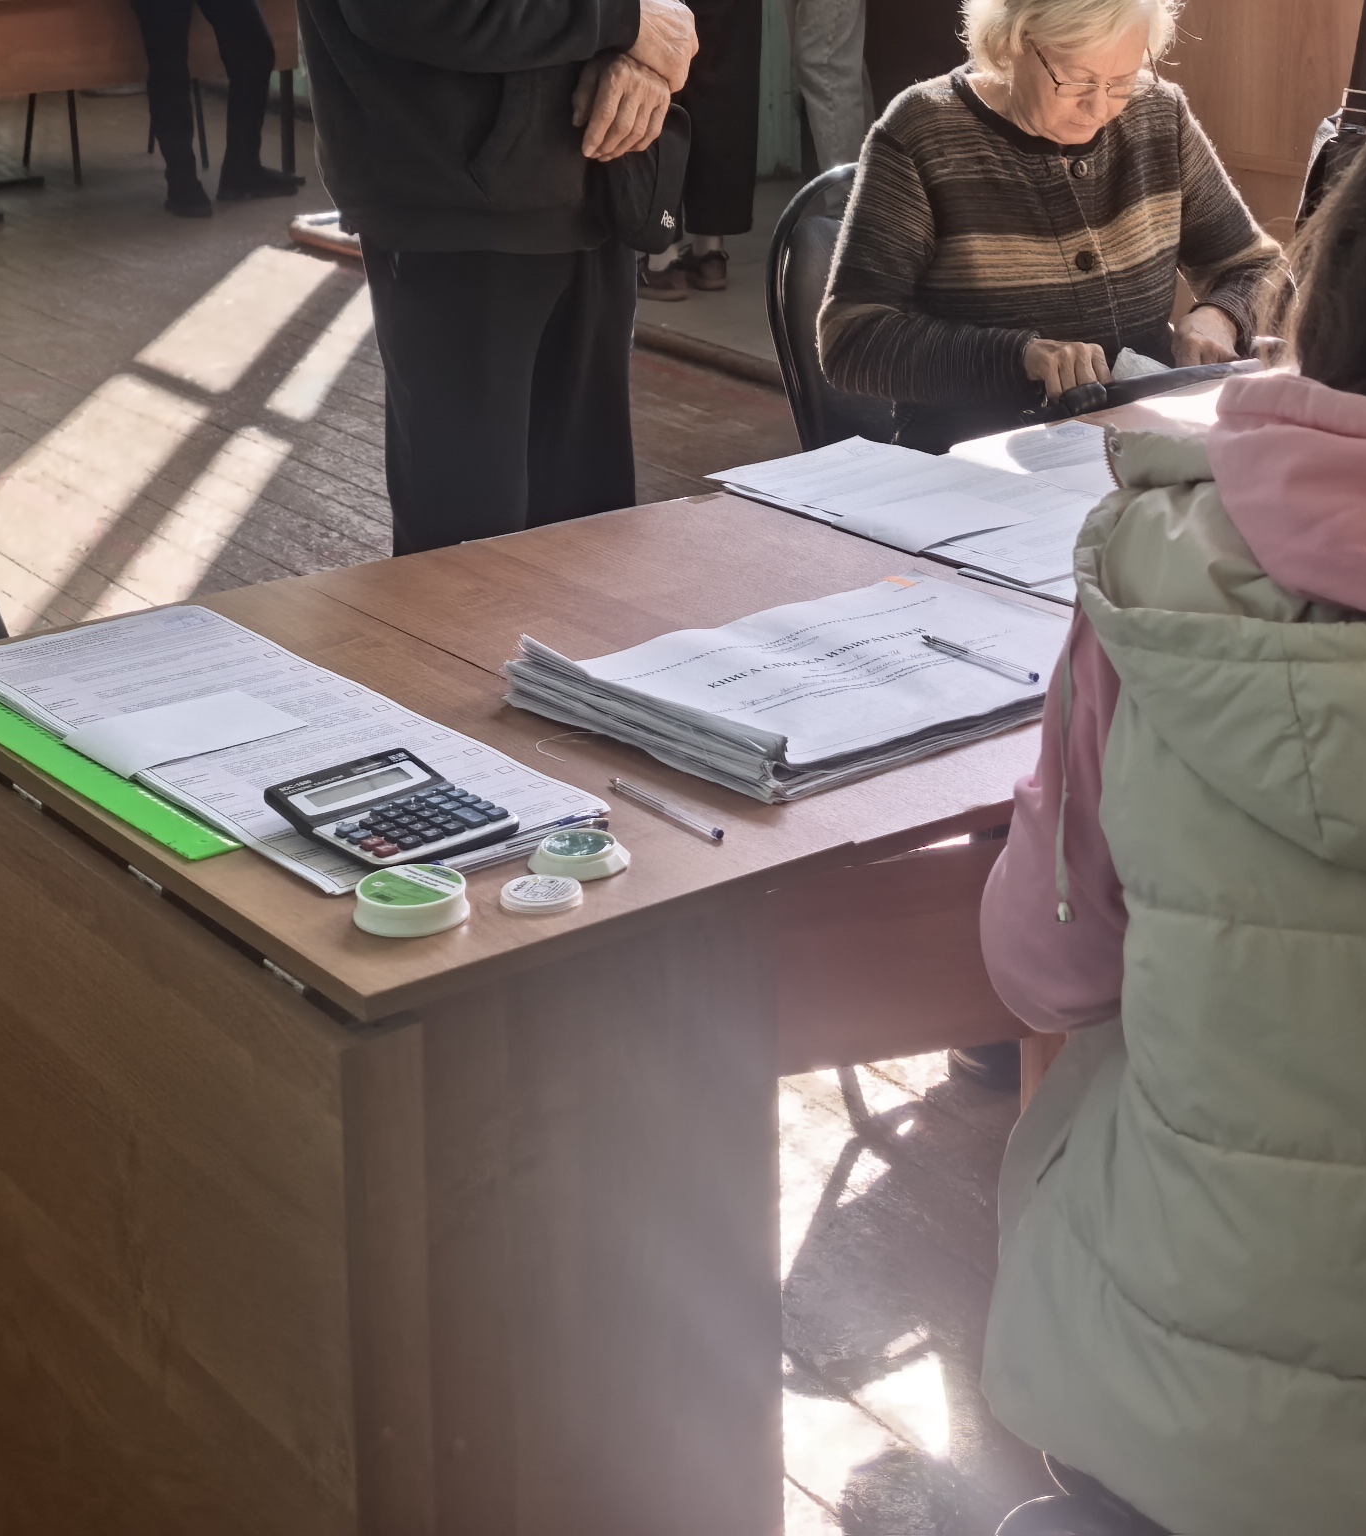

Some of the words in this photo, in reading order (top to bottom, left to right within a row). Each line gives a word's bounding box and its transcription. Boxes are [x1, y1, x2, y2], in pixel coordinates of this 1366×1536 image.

[707, 667, 762, 689] КНИГА
[763, 655, 826, 670] СПИСКА
[826, 627, 927, 659] ИЗБИРАТЕЛЕЙ
